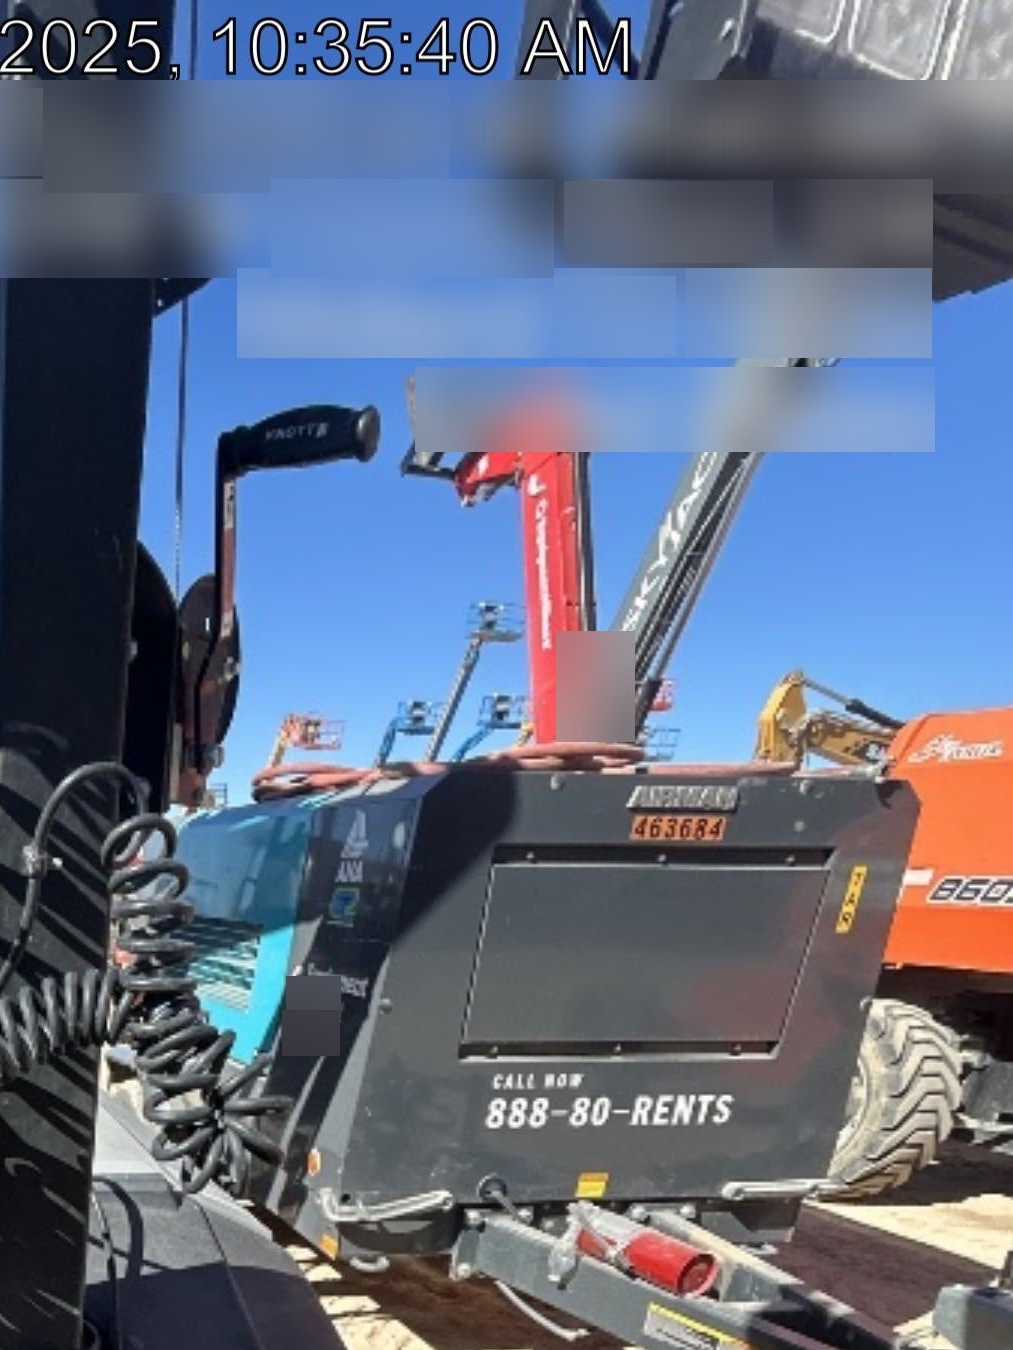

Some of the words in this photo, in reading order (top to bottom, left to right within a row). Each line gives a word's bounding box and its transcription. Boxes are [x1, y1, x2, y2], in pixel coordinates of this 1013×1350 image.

[634, 817, 724, 840] 463684
[492, 1073, 537, 1090] CALL
[544, 1073, 585, 1089] NOW
[485, 1095, 735, 1129] 888-80-RENTS
